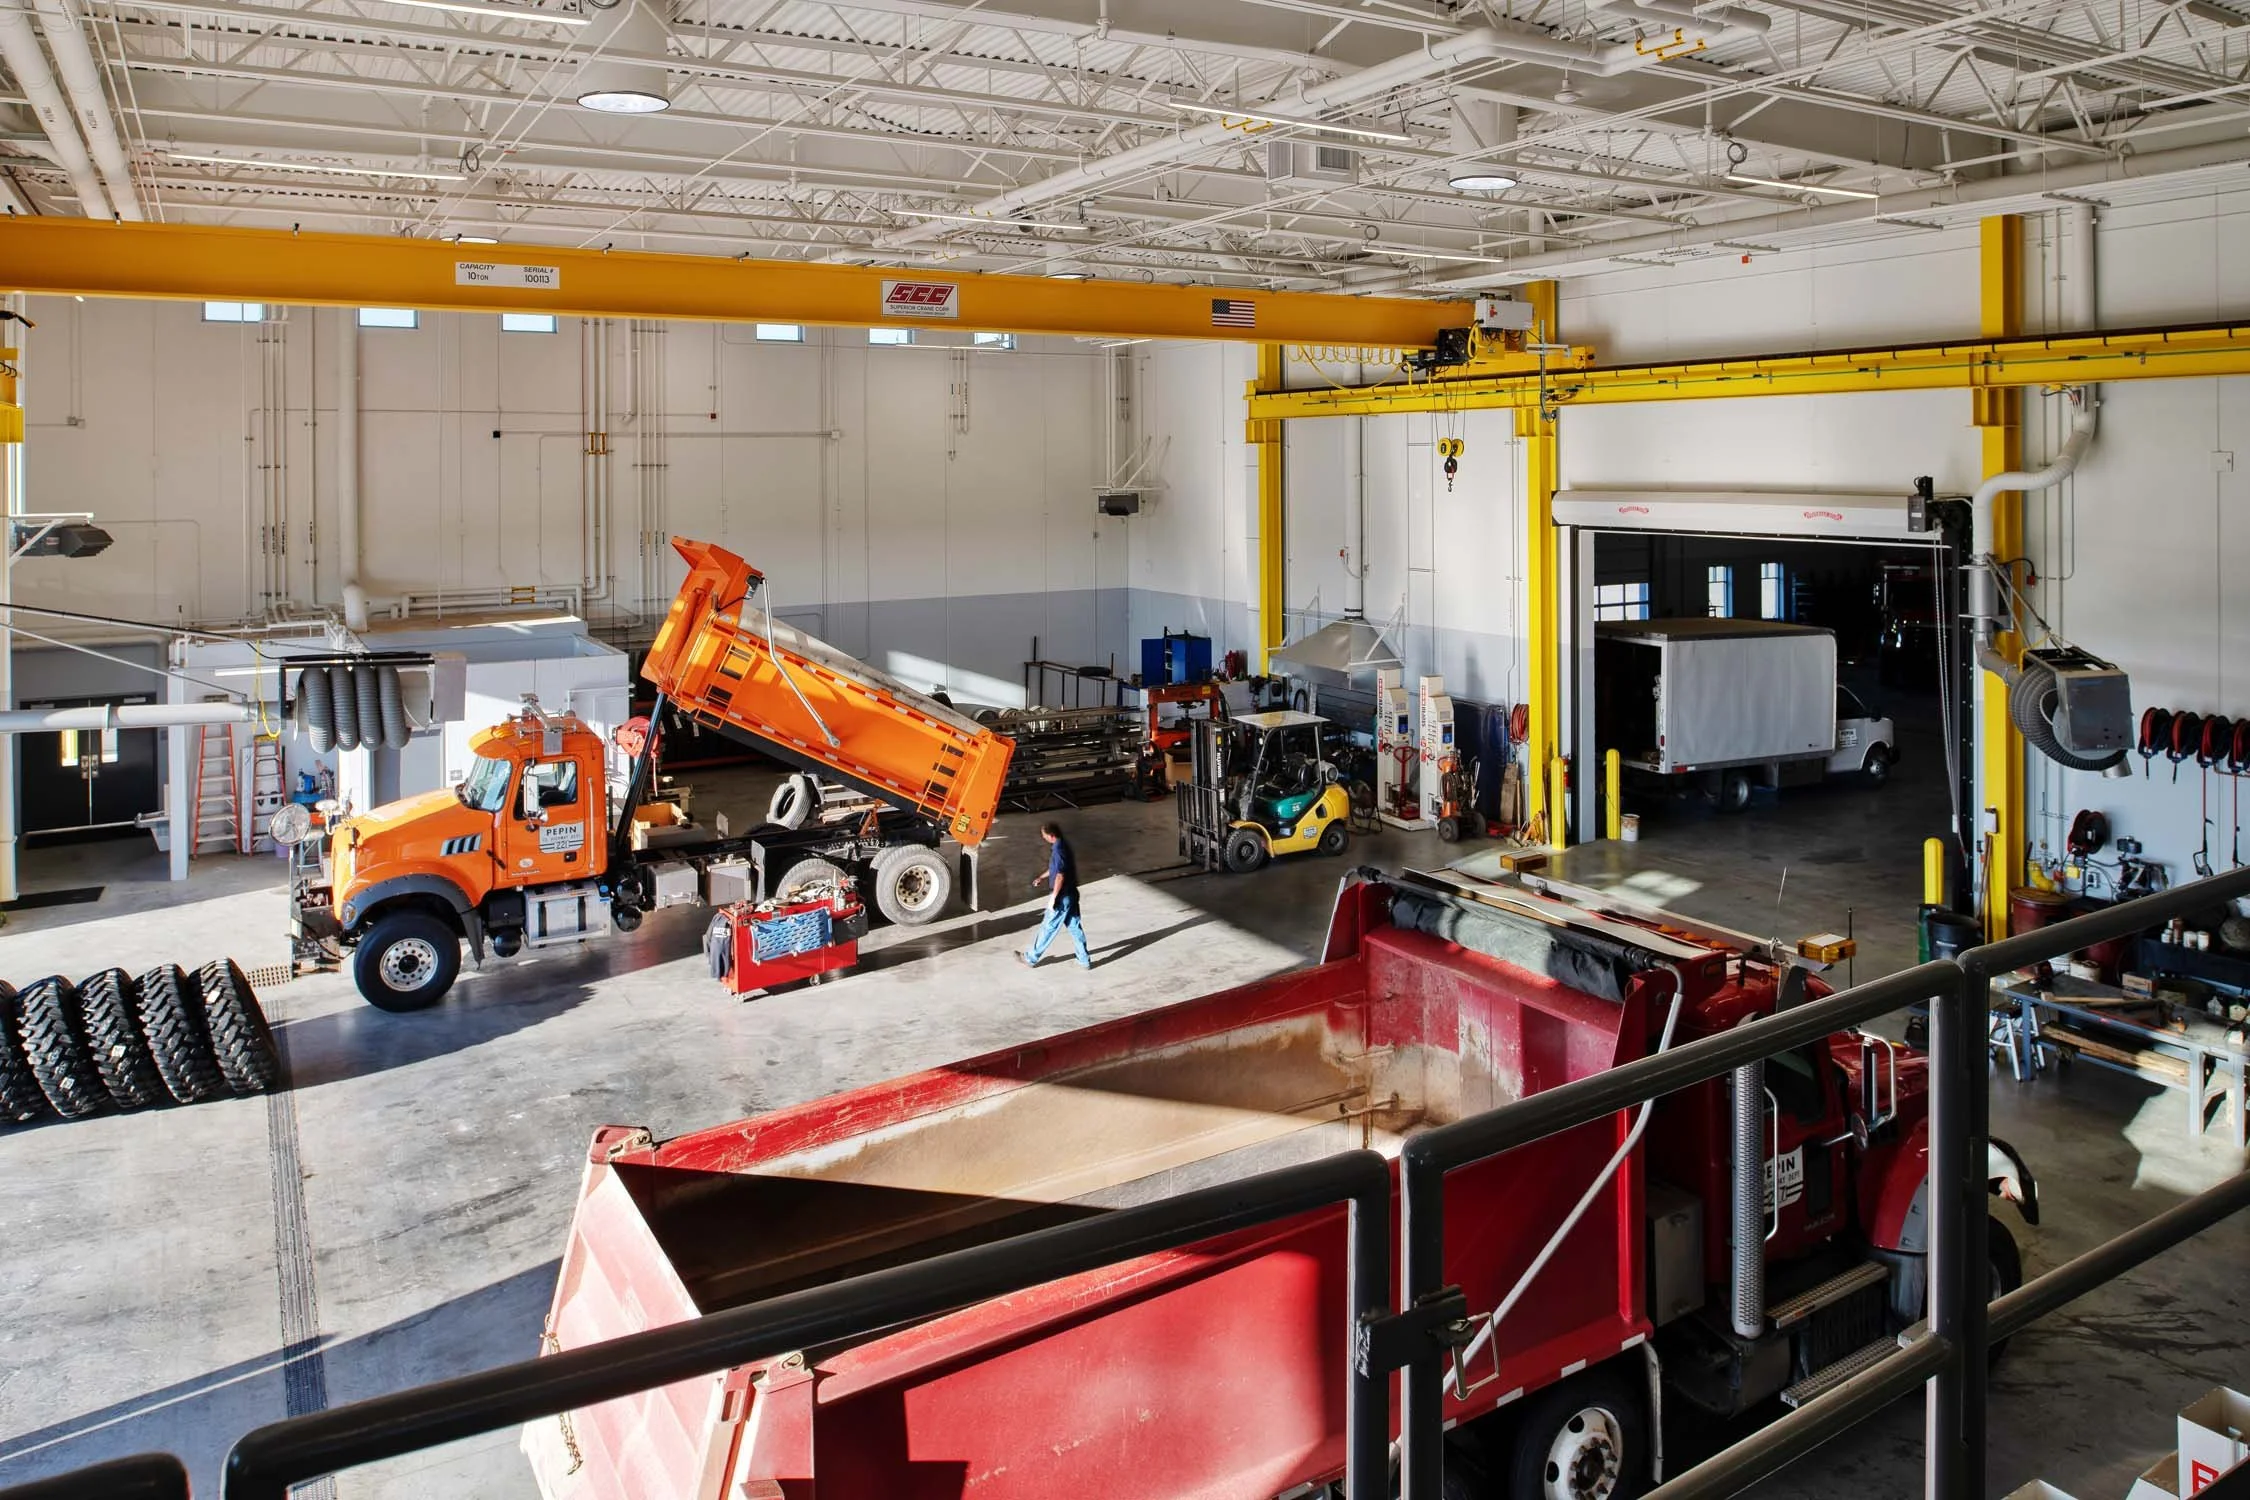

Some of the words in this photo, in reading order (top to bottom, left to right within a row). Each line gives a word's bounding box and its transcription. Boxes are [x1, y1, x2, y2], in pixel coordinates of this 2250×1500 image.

[459, 263, 496, 271] CAPACITY
[523, 266, 548, 274] SERIAL
[467, 271, 477, 280] 10
[524, 274, 550, 284] 100113
[546, 825, 577, 836] PEPIN
[1766, 1157, 1795, 1179] EIN
